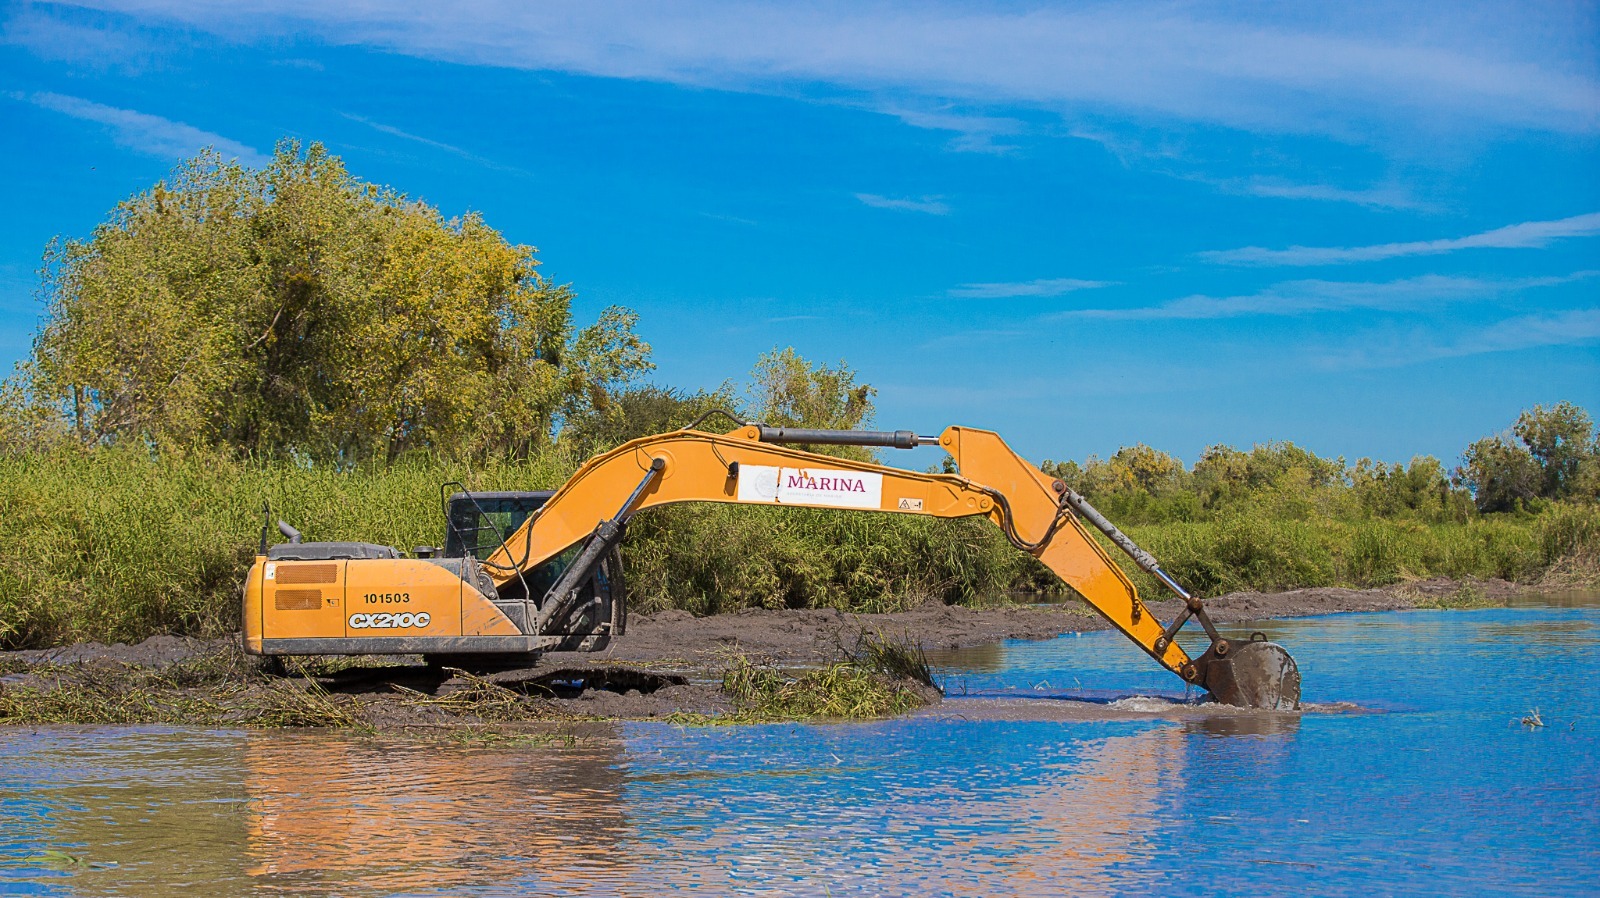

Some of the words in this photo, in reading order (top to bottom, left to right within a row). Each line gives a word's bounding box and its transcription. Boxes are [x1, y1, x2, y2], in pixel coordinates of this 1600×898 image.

[788, 475, 866, 493] MARINA
[363, 593, 410, 604] 101503
[349, 612, 431, 629] CX210C
